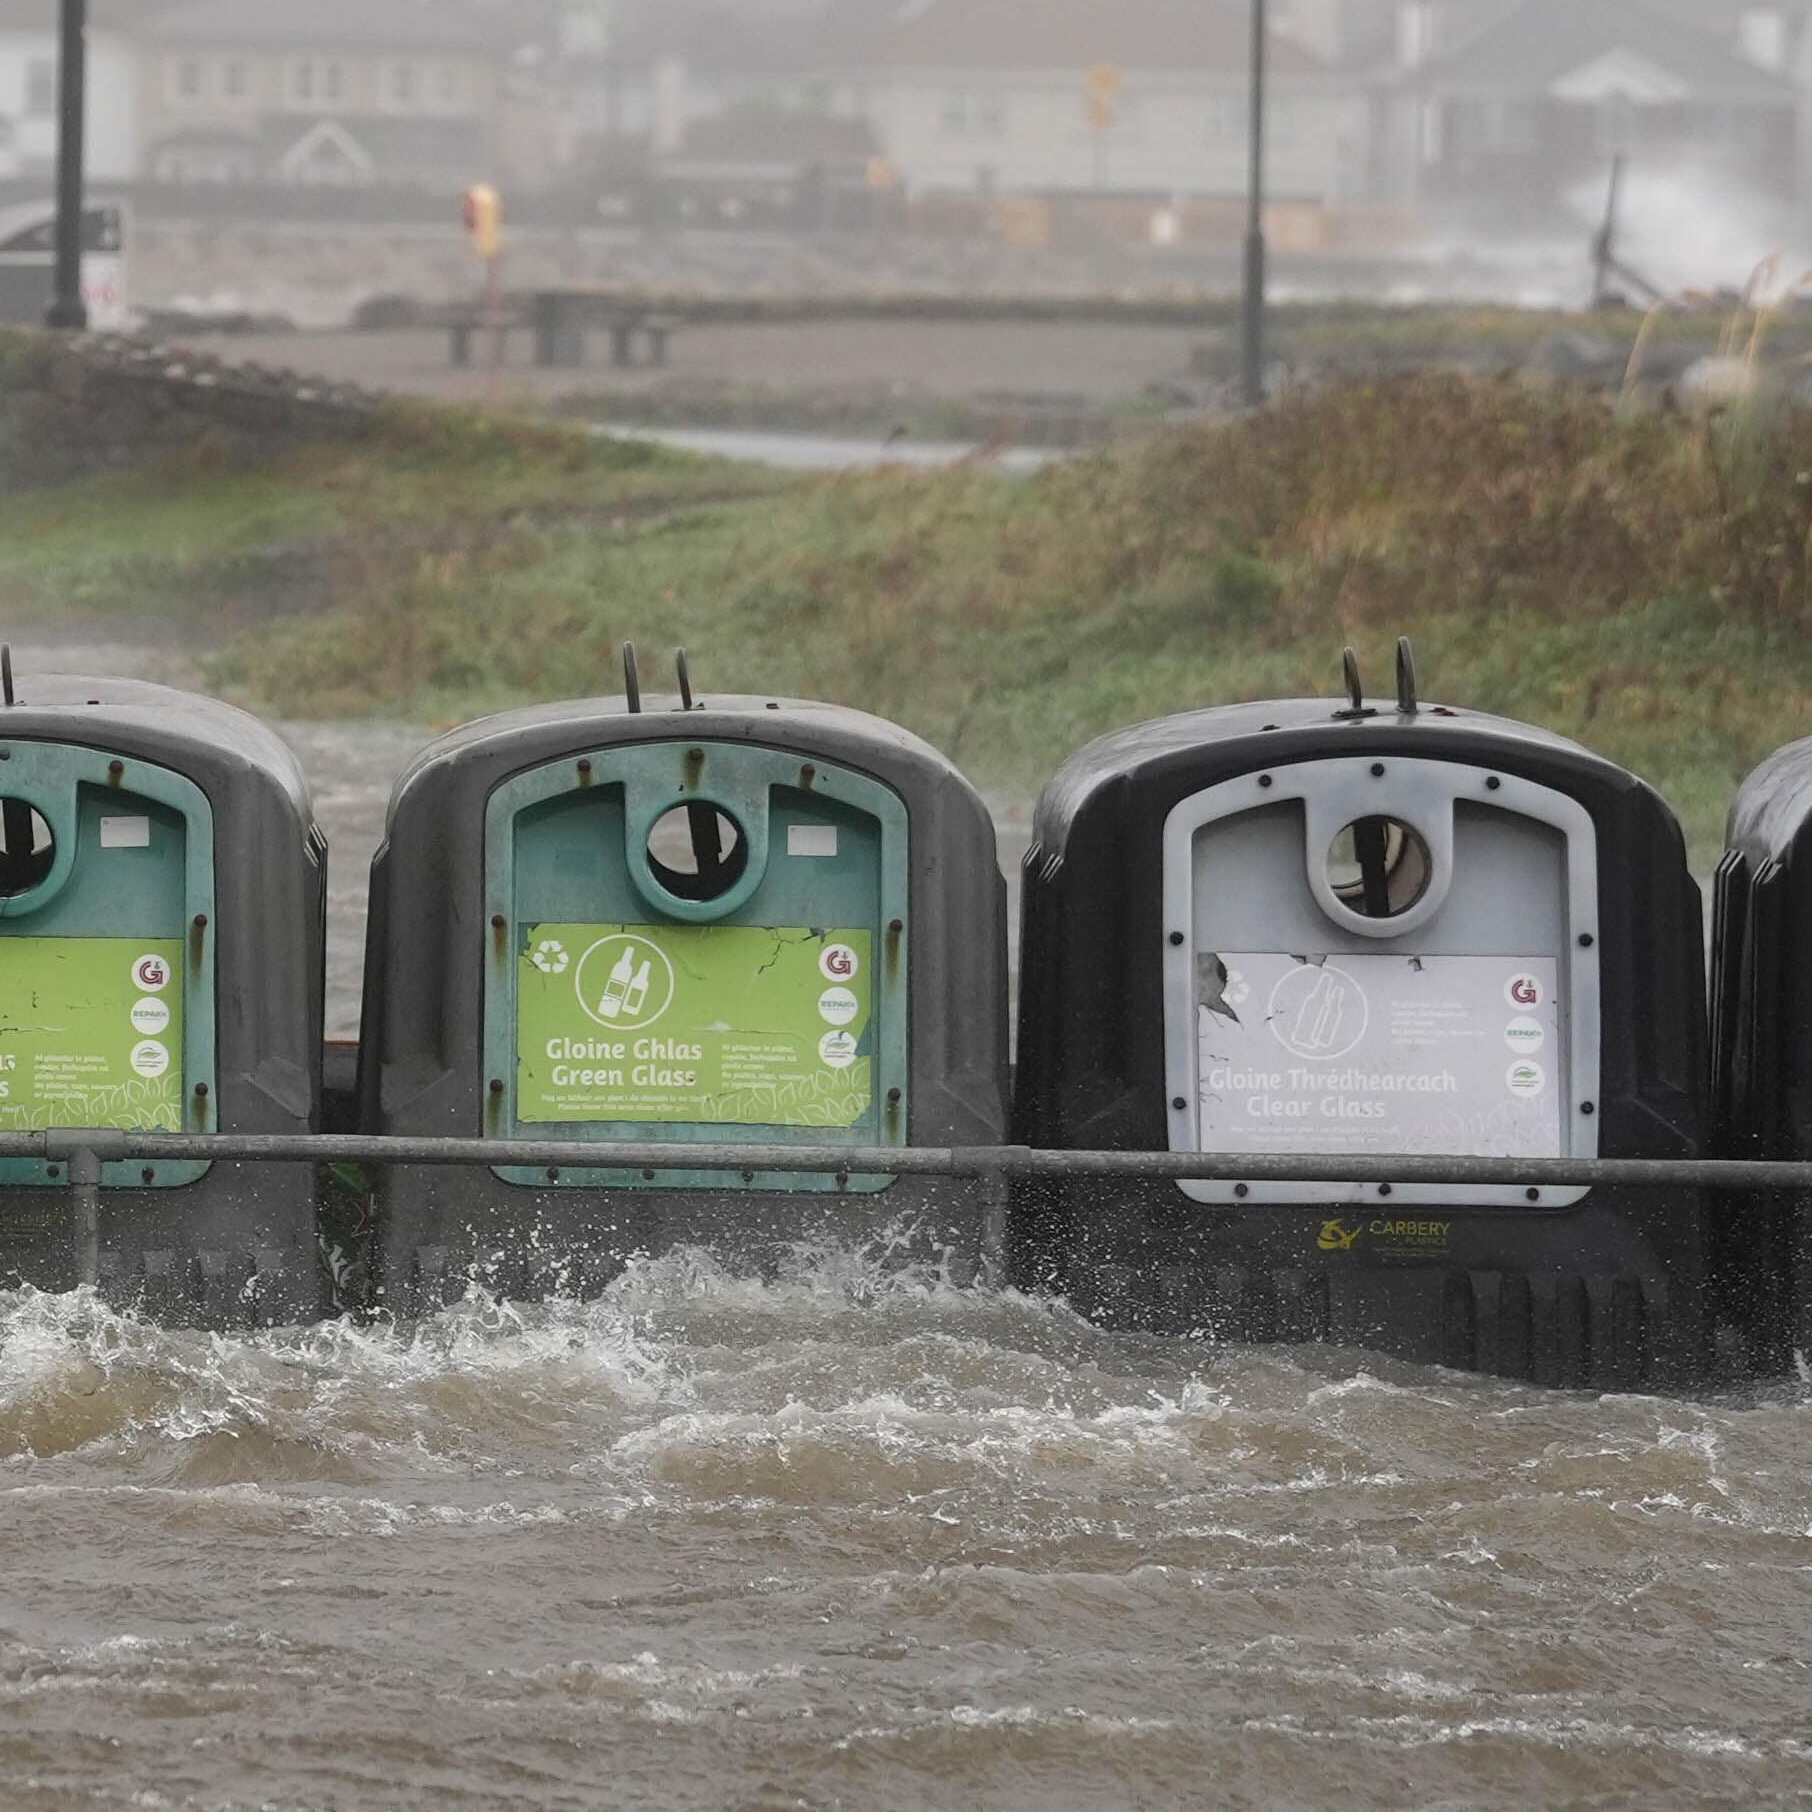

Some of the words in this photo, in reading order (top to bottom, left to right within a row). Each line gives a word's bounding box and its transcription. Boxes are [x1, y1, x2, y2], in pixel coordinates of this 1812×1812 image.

[545, 1037, 625, 1060] Gloine
[633, 1038, 702, 1060] Ghlas
[551, 1065, 624, 1086] Green
[631, 1064, 697, 1086] Glass
[1209, 1066, 1281, 1090] Gloine
[1287, 1068, 1458, 1092] Thrédhearcach
[1246, 1095, 1312, 1117] Clear
[1319, 1095, 1385, 1118] Glass
[1369, 1220, 1450, 1236] CARBERY
